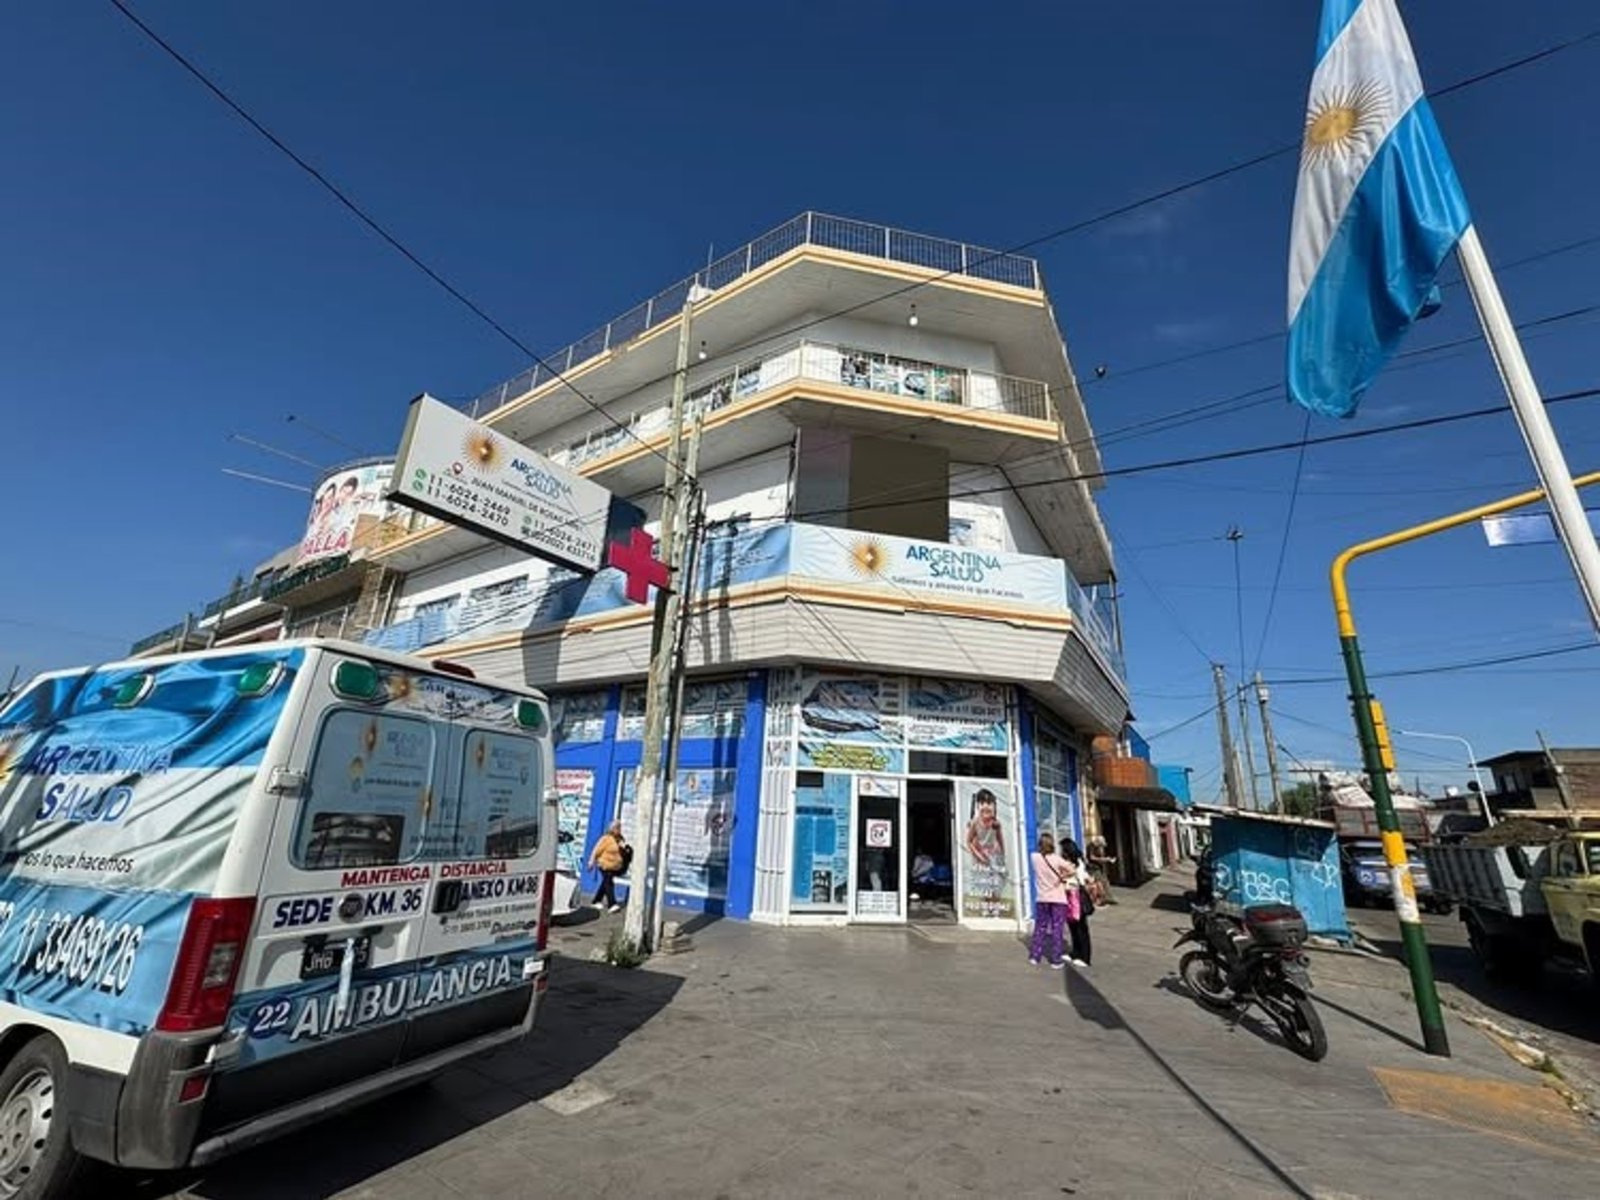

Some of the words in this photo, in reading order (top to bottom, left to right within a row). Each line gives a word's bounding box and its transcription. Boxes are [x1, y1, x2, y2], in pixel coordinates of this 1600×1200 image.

[471, 476, 494, 493] JUAN
[510, 457, 573, 495] ARGENTINA
[524, 474, 560, 500] SALUD
[905, 545, 1002, 571] ARGENTINA
[929, 562, 984, 583] SALUD
[23, 745, 172, 776] ARGENTINA
[36, 781, 133, 822] SALUD
[53, 854, 75, 873] que
[76, 850, 135, 873] hacemos
[341, 865, 430, 888] MANTENGA
[440, 861, 507, 877] DISTANCIA
[460, 879, 505, 901] ANEXO
[273, 896, 334, 928] SEDE
[401, 889, 422, 912] 36
[254, 1001, 292, 1033] 22
[289, 954, 512, 1042] AMBULANCIA
